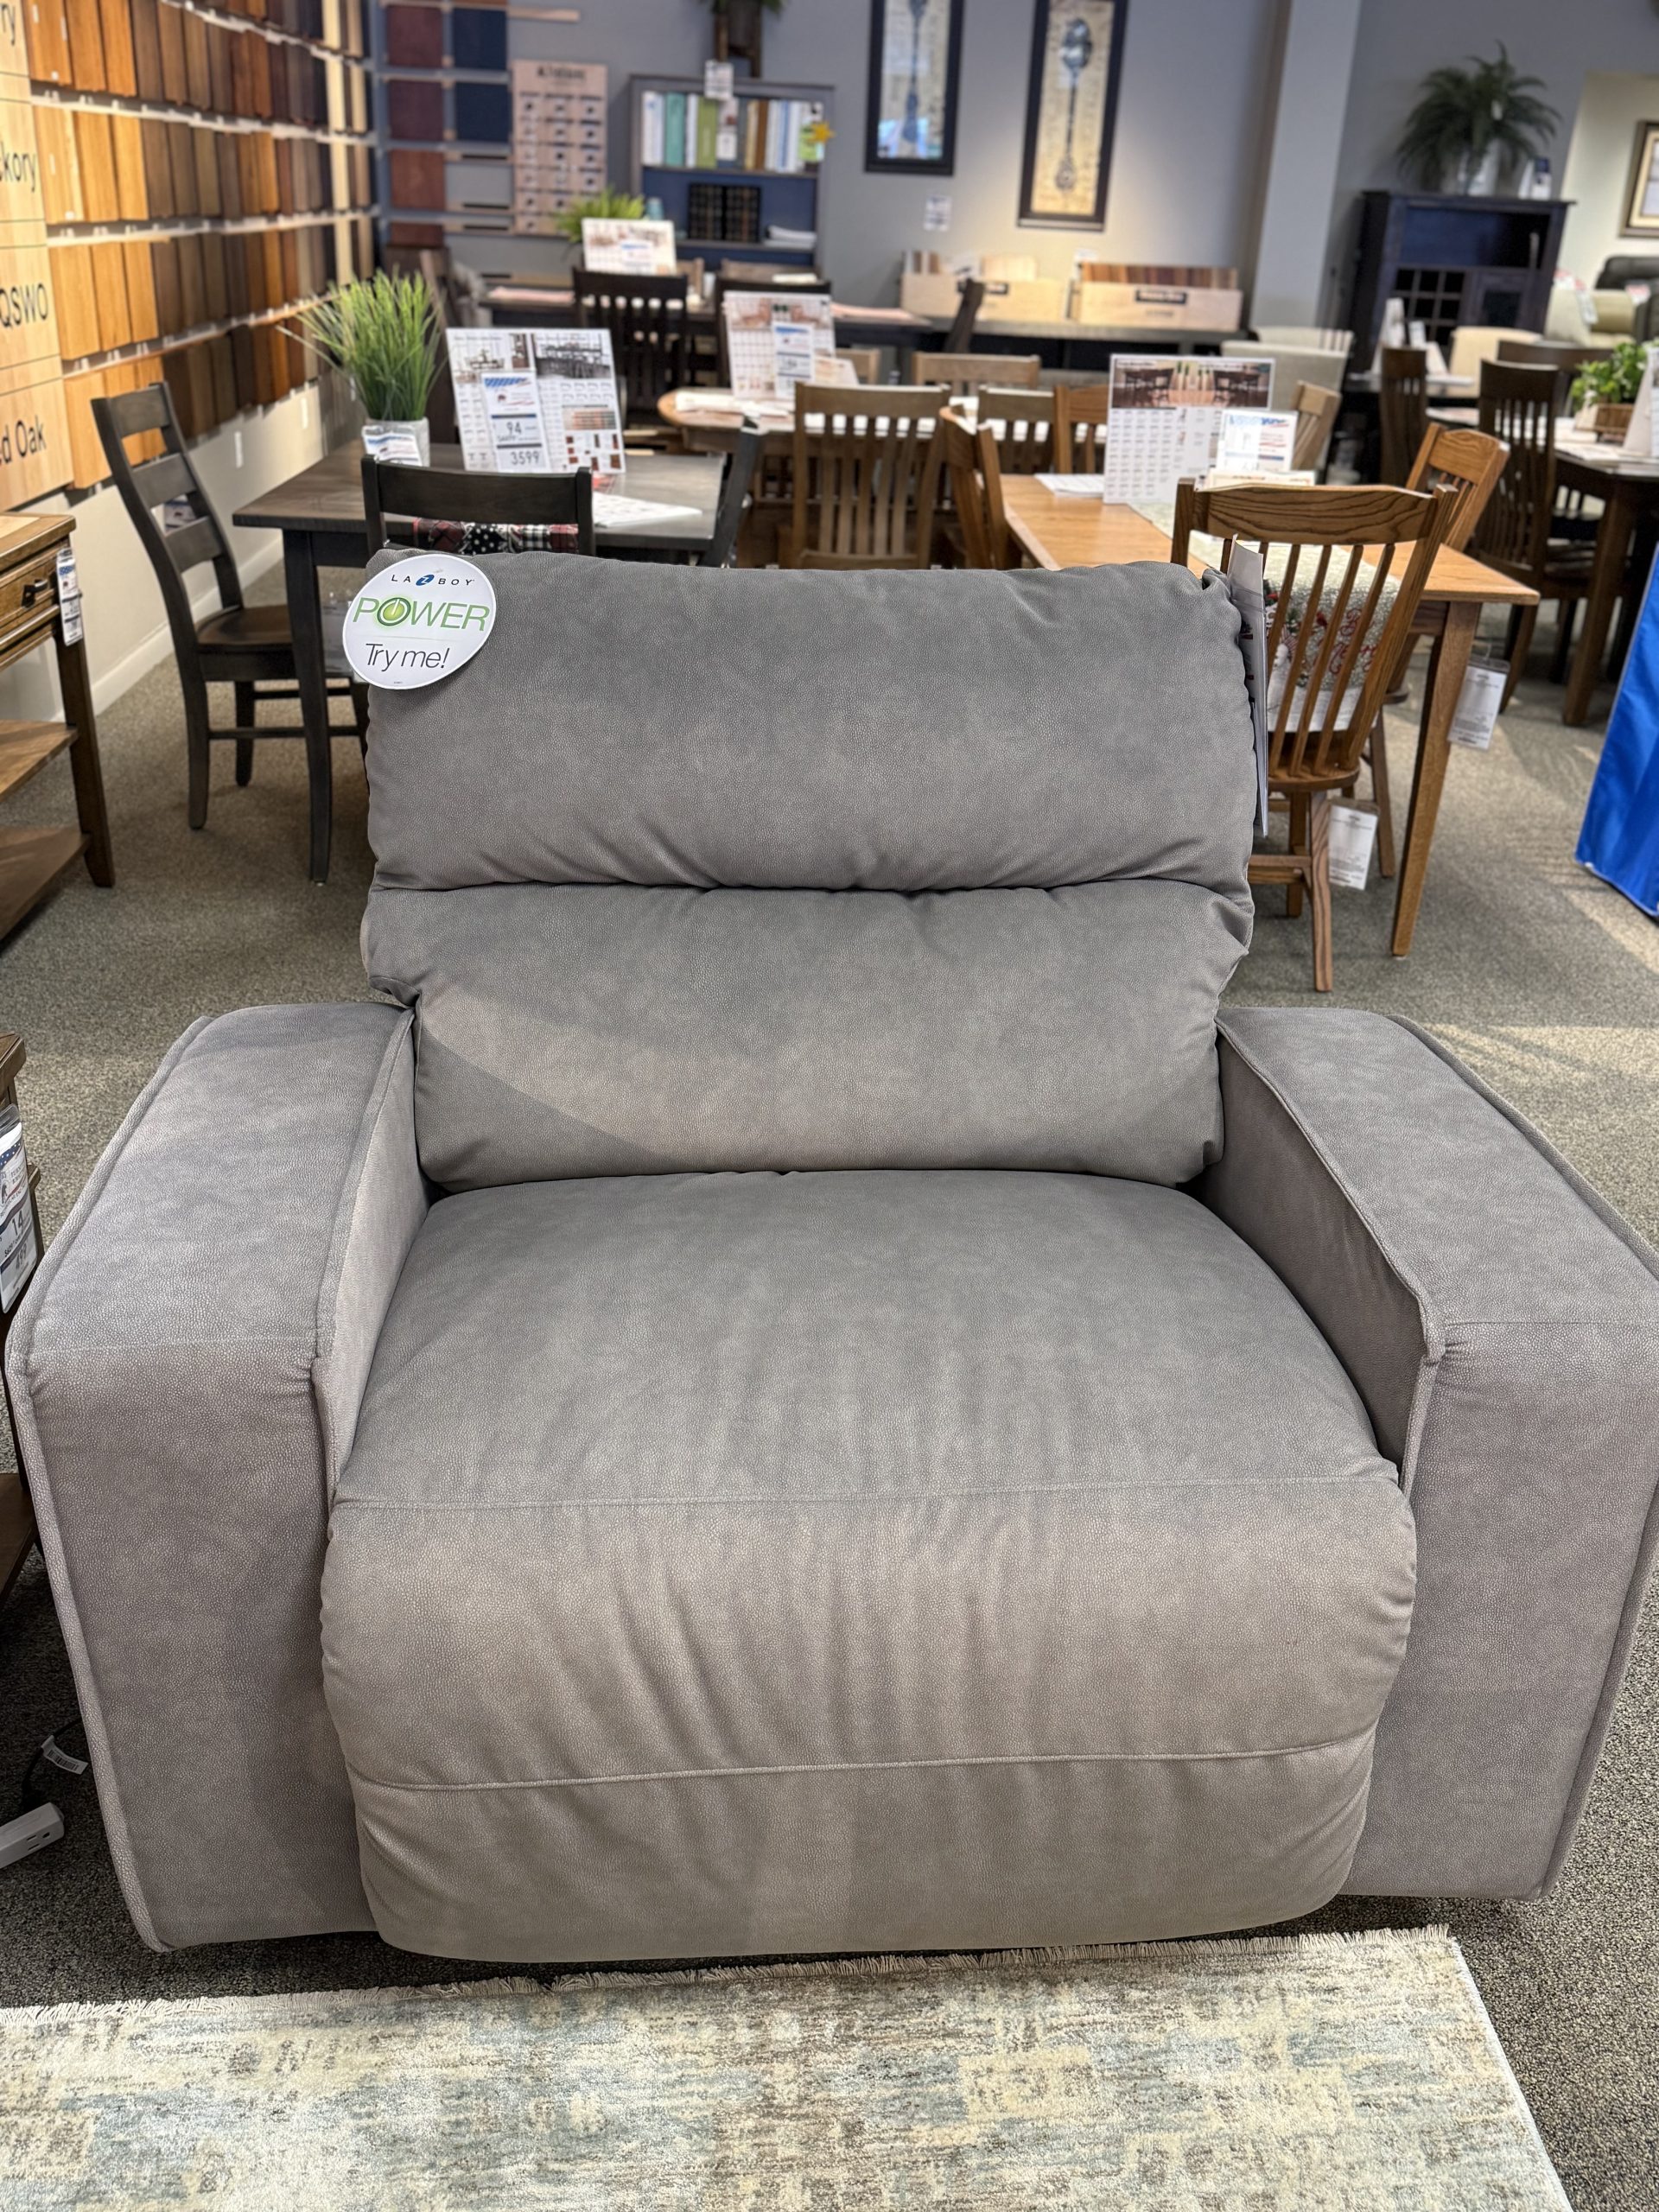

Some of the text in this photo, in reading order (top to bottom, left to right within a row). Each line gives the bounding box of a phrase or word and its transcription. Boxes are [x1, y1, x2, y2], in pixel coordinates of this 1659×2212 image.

[0, 141, 36, 193] kory
[15, 415, 46, 458] Oak
[511, 451, 540, 465] 3599
[353, 596, 490, 632] POWER
[365, 643, 450, 672] Try me!
[11, 1210, 24, 1236] 14
